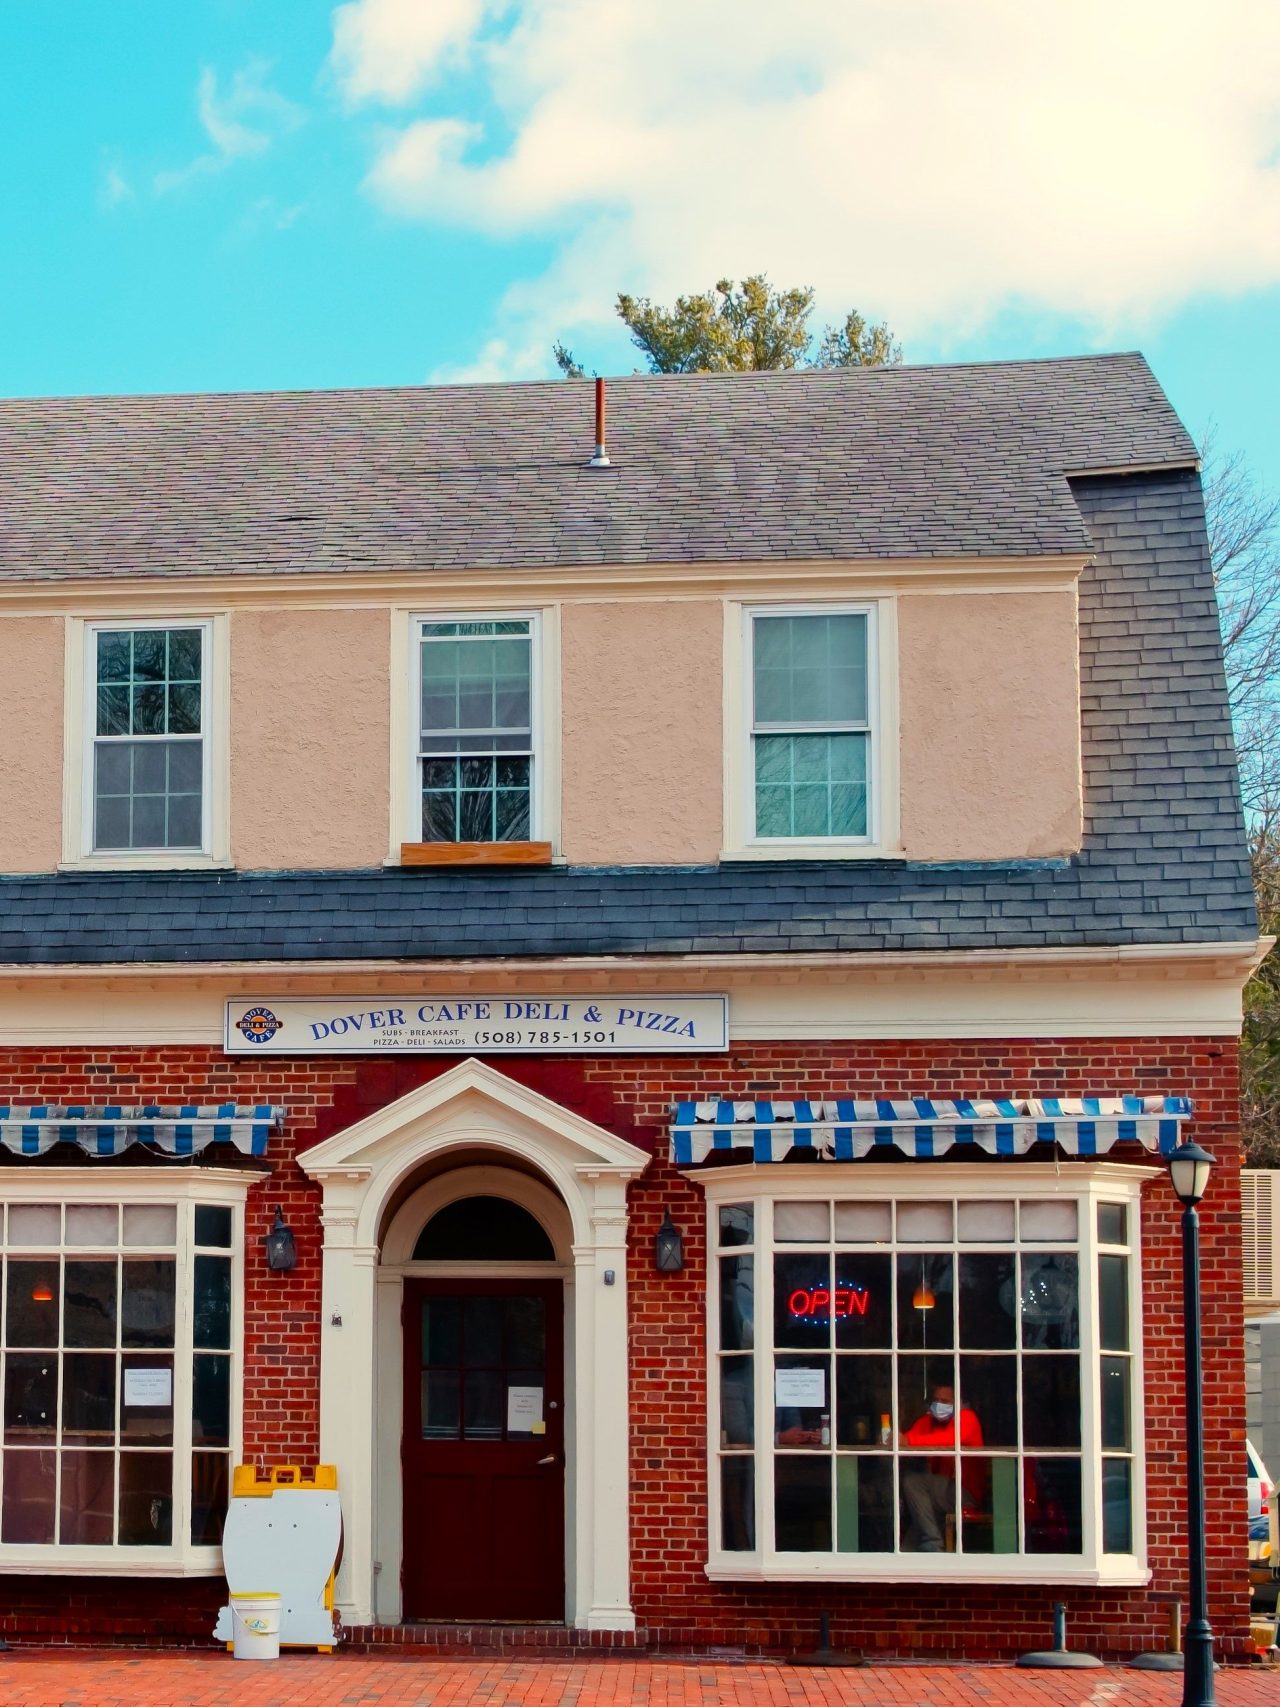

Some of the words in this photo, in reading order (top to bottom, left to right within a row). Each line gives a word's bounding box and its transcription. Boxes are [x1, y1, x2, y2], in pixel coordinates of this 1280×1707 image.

[245, 1009, 274, 1021] DOVER
[309, 1008, 406, 1040] DOVER
[418, 1003, 491, 1022] CAFE
[504, 1002, 571, 1021] DELI
[583, 1005, 602, 1023] &
[616, 1008, 696, 1038] PIZZA
[433, 1038, 466, 1046] SALADS
[474, 1031, 522, 1045] (508)
[528, 1031, 616, 1044] 785-1501
[787, 1289, 869, 1315] OPEN
